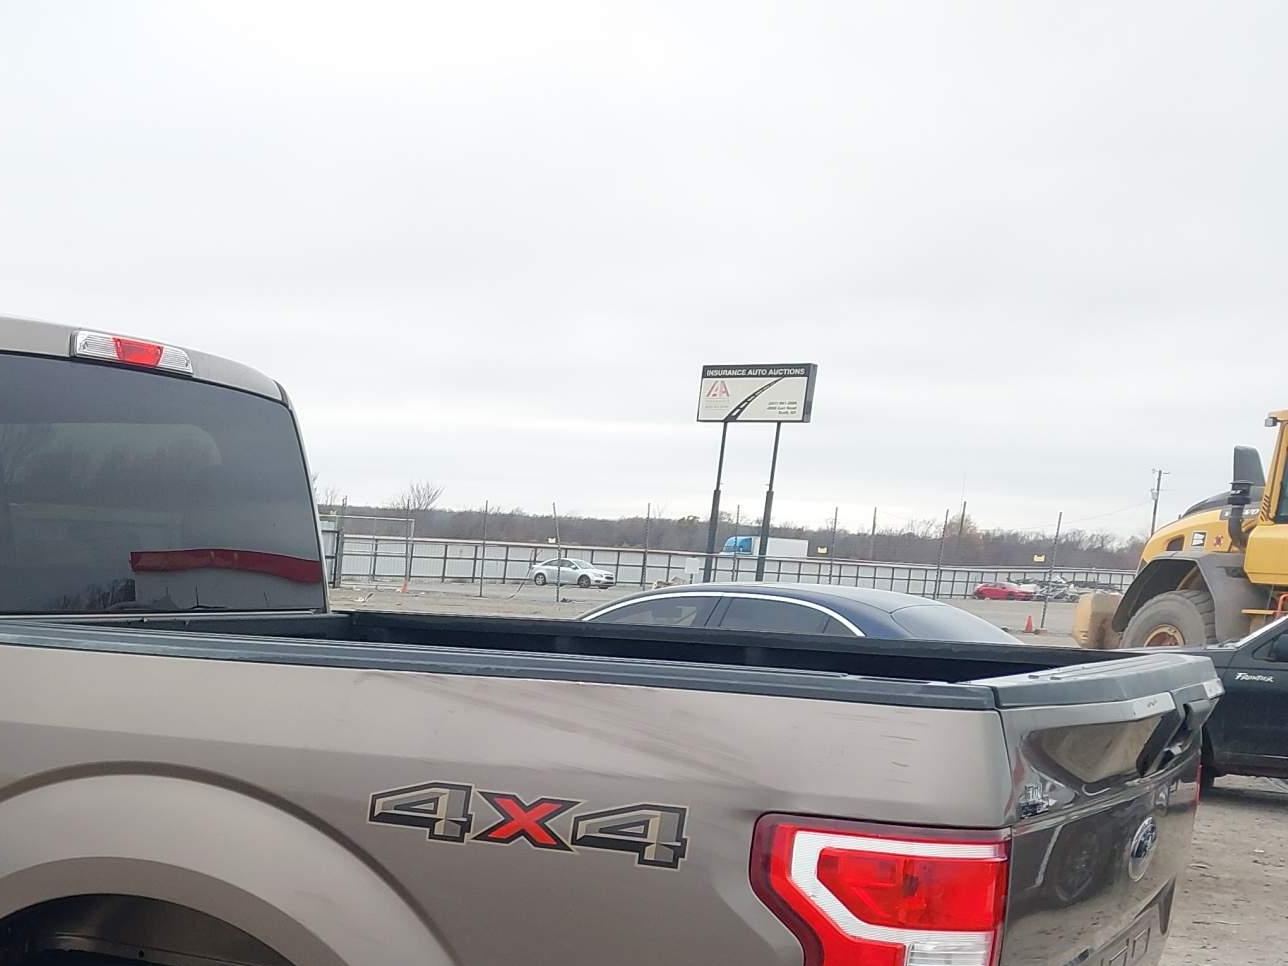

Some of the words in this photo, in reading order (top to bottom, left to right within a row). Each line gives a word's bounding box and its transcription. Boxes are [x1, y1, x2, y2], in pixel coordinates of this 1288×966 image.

[706, 369, 746, 377] INSURANCE
[747, 368, 767, 376] AUTO
[768, 367, 805, 376] AUCTIONS
